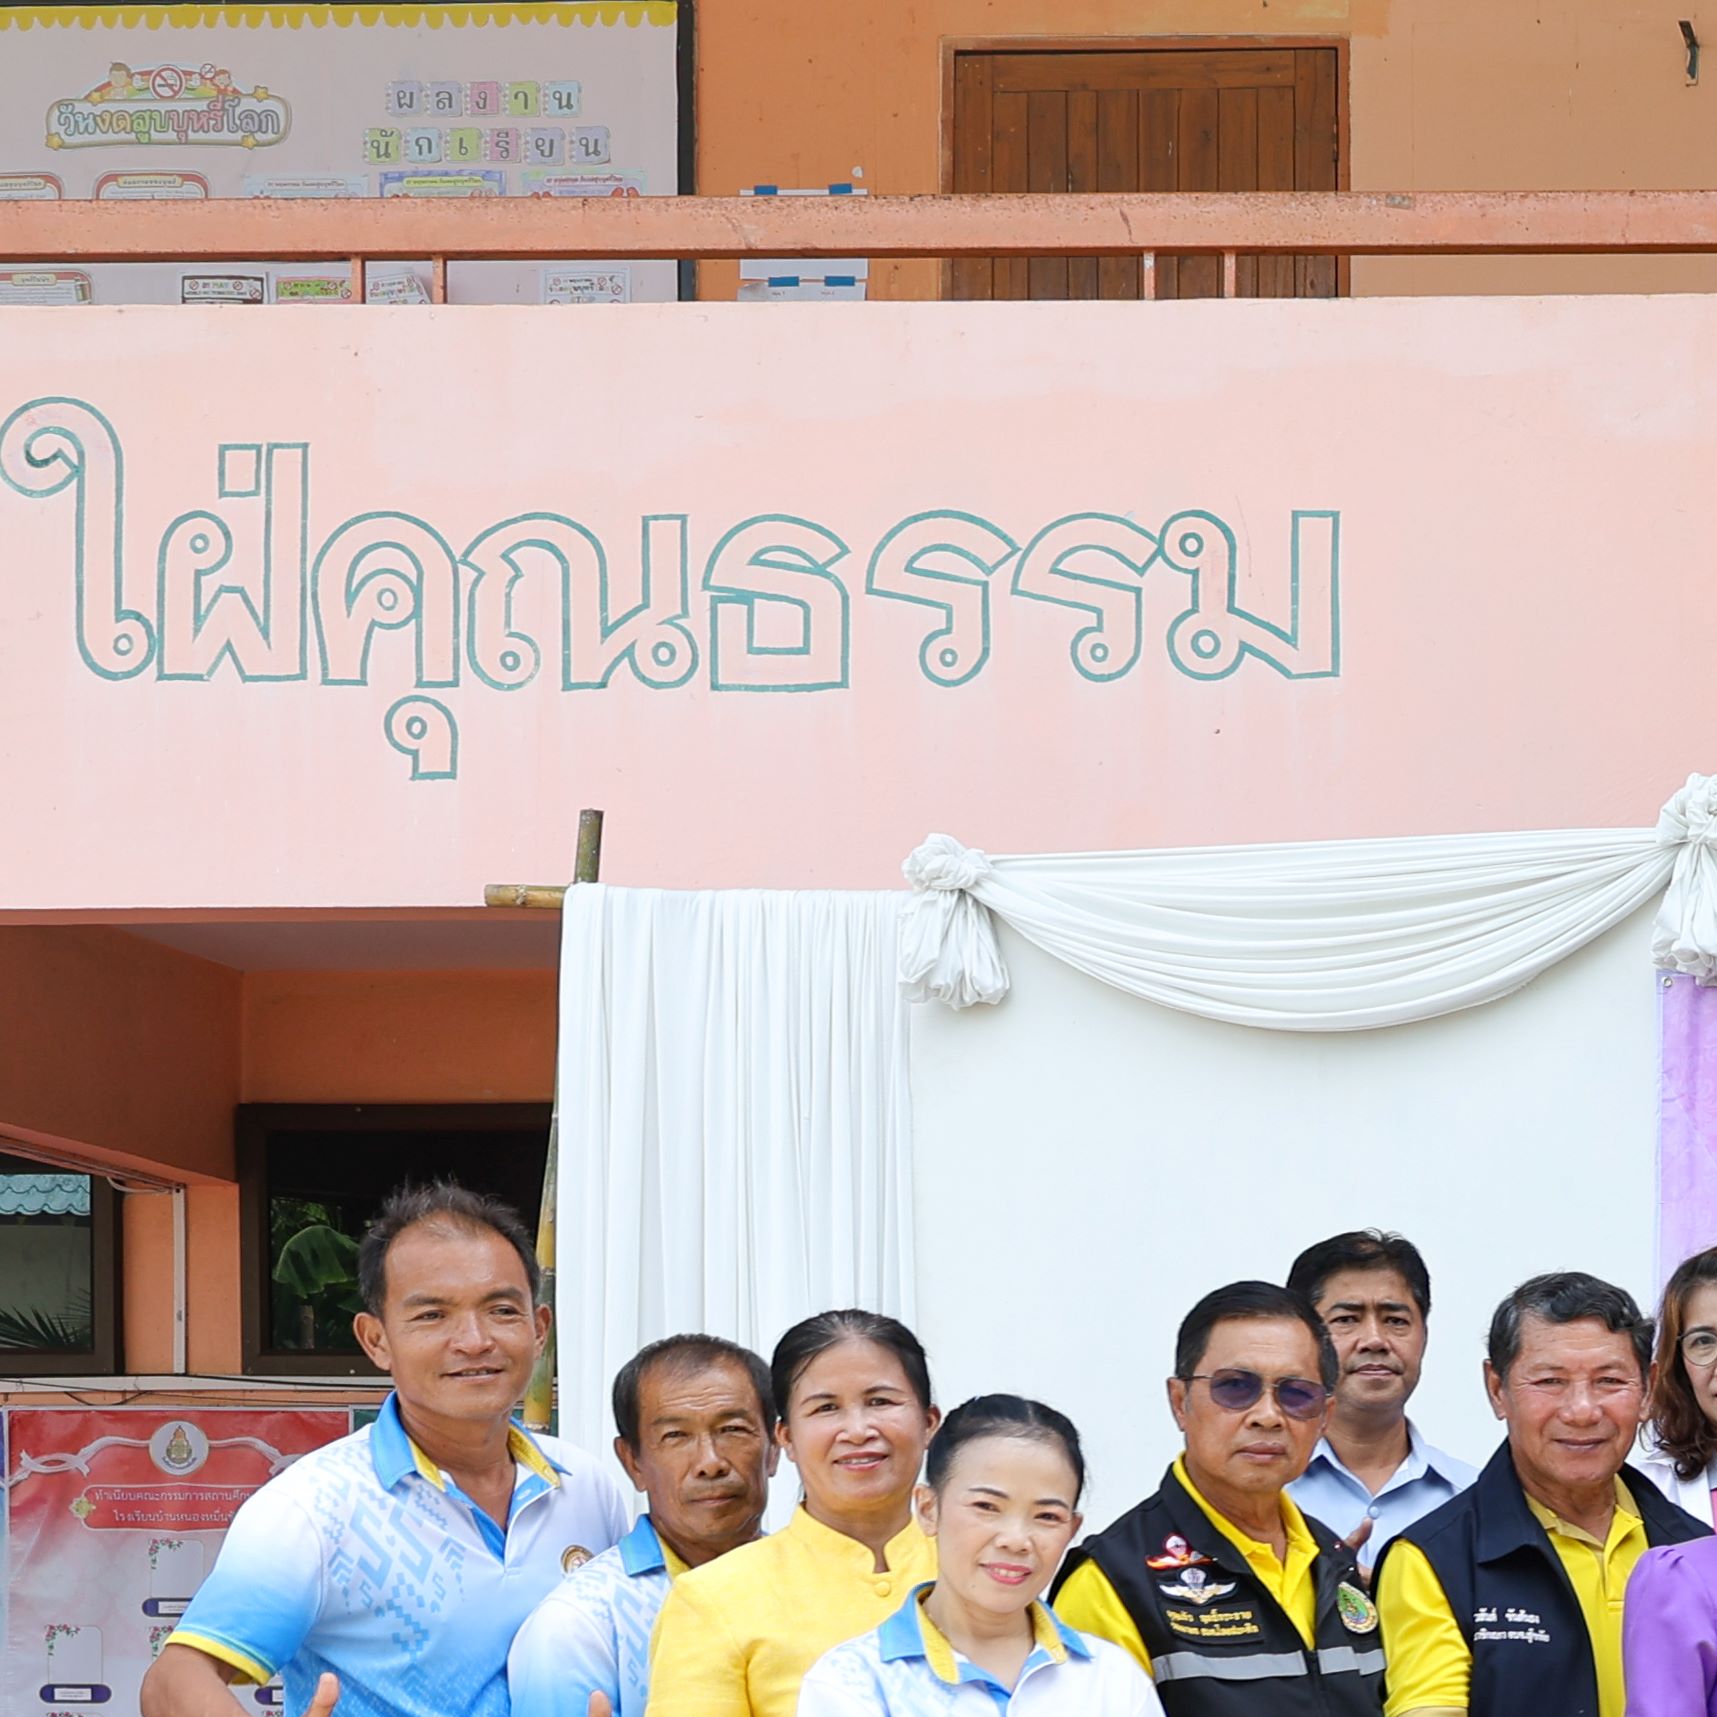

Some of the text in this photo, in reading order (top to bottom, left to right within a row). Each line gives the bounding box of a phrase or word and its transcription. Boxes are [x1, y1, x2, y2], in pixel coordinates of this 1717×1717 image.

[57, 96, 281, 144] วันงดสูบบุหรี่โลก
[0, 397, 1341, 780] ใฝ่คุณธรรม
